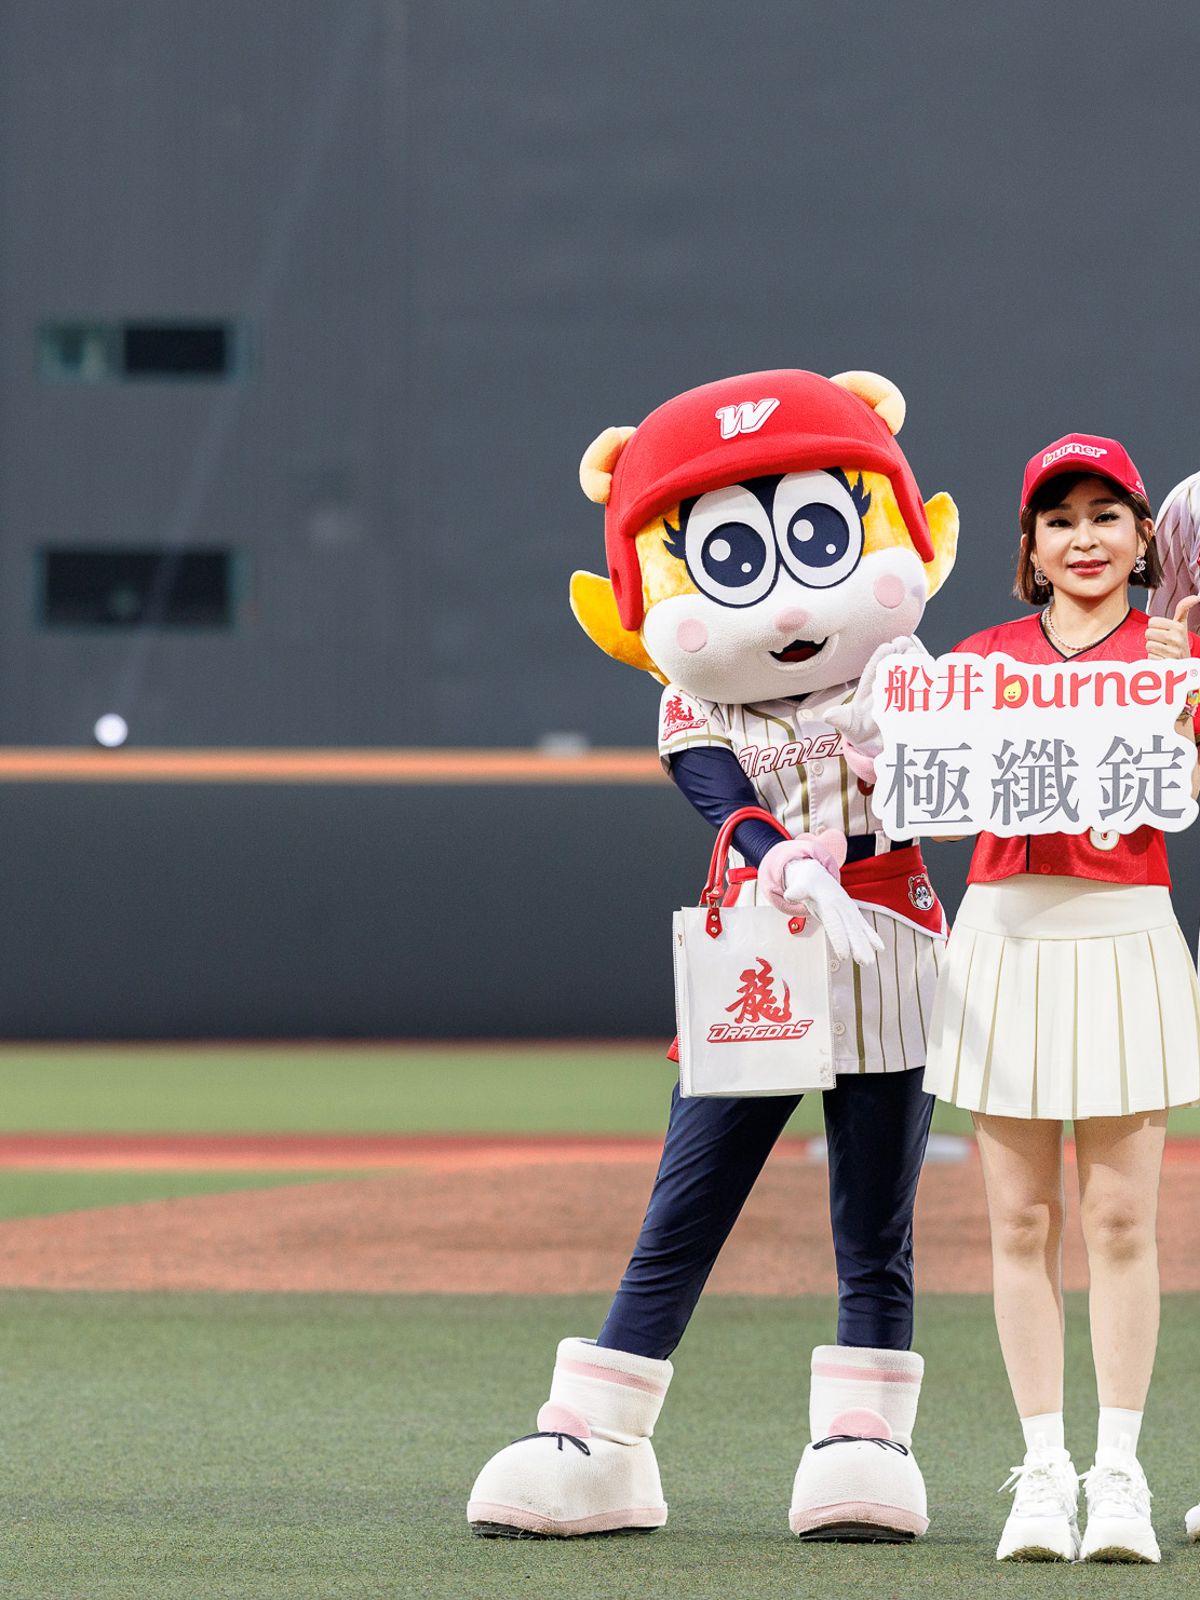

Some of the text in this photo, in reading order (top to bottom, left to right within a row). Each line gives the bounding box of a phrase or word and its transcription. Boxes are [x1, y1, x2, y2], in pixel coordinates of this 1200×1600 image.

[715, 398, 780, 440] W
[1042, 443, 1107, 468] burner
[884, 664, 984, 713] 船井
[993, 663, 1187, 710] burner
[739, 733, 844, 779] DRAG
[884, 735, 1187, 829] 極纖錠
[706, 1019, 814, 1043] DRAGONS
